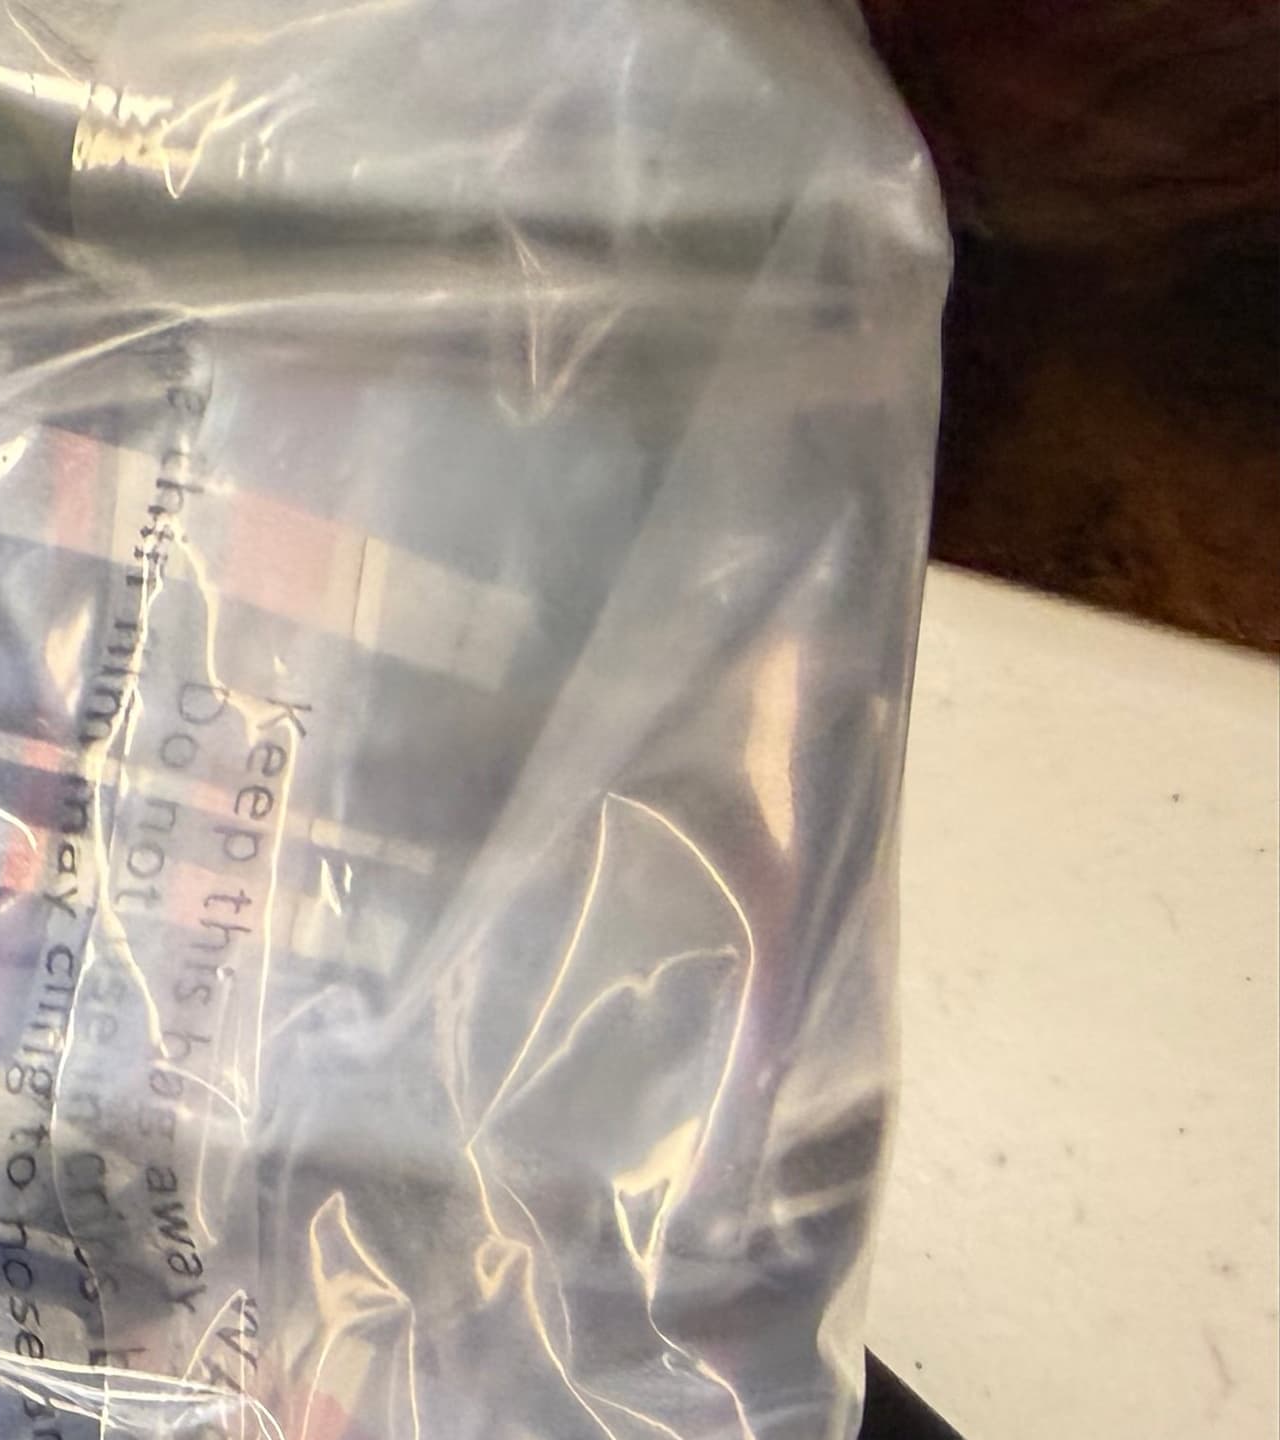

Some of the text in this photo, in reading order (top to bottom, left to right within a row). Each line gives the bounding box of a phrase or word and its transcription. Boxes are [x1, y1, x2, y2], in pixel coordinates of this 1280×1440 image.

[158, 682, 229, 771] Do
[212, 697, 313, 863] Keep
[172, 889, 252, 1006] this
[5, 1123, 51, 1192] to
[143, 1166, 208, 1316] away
